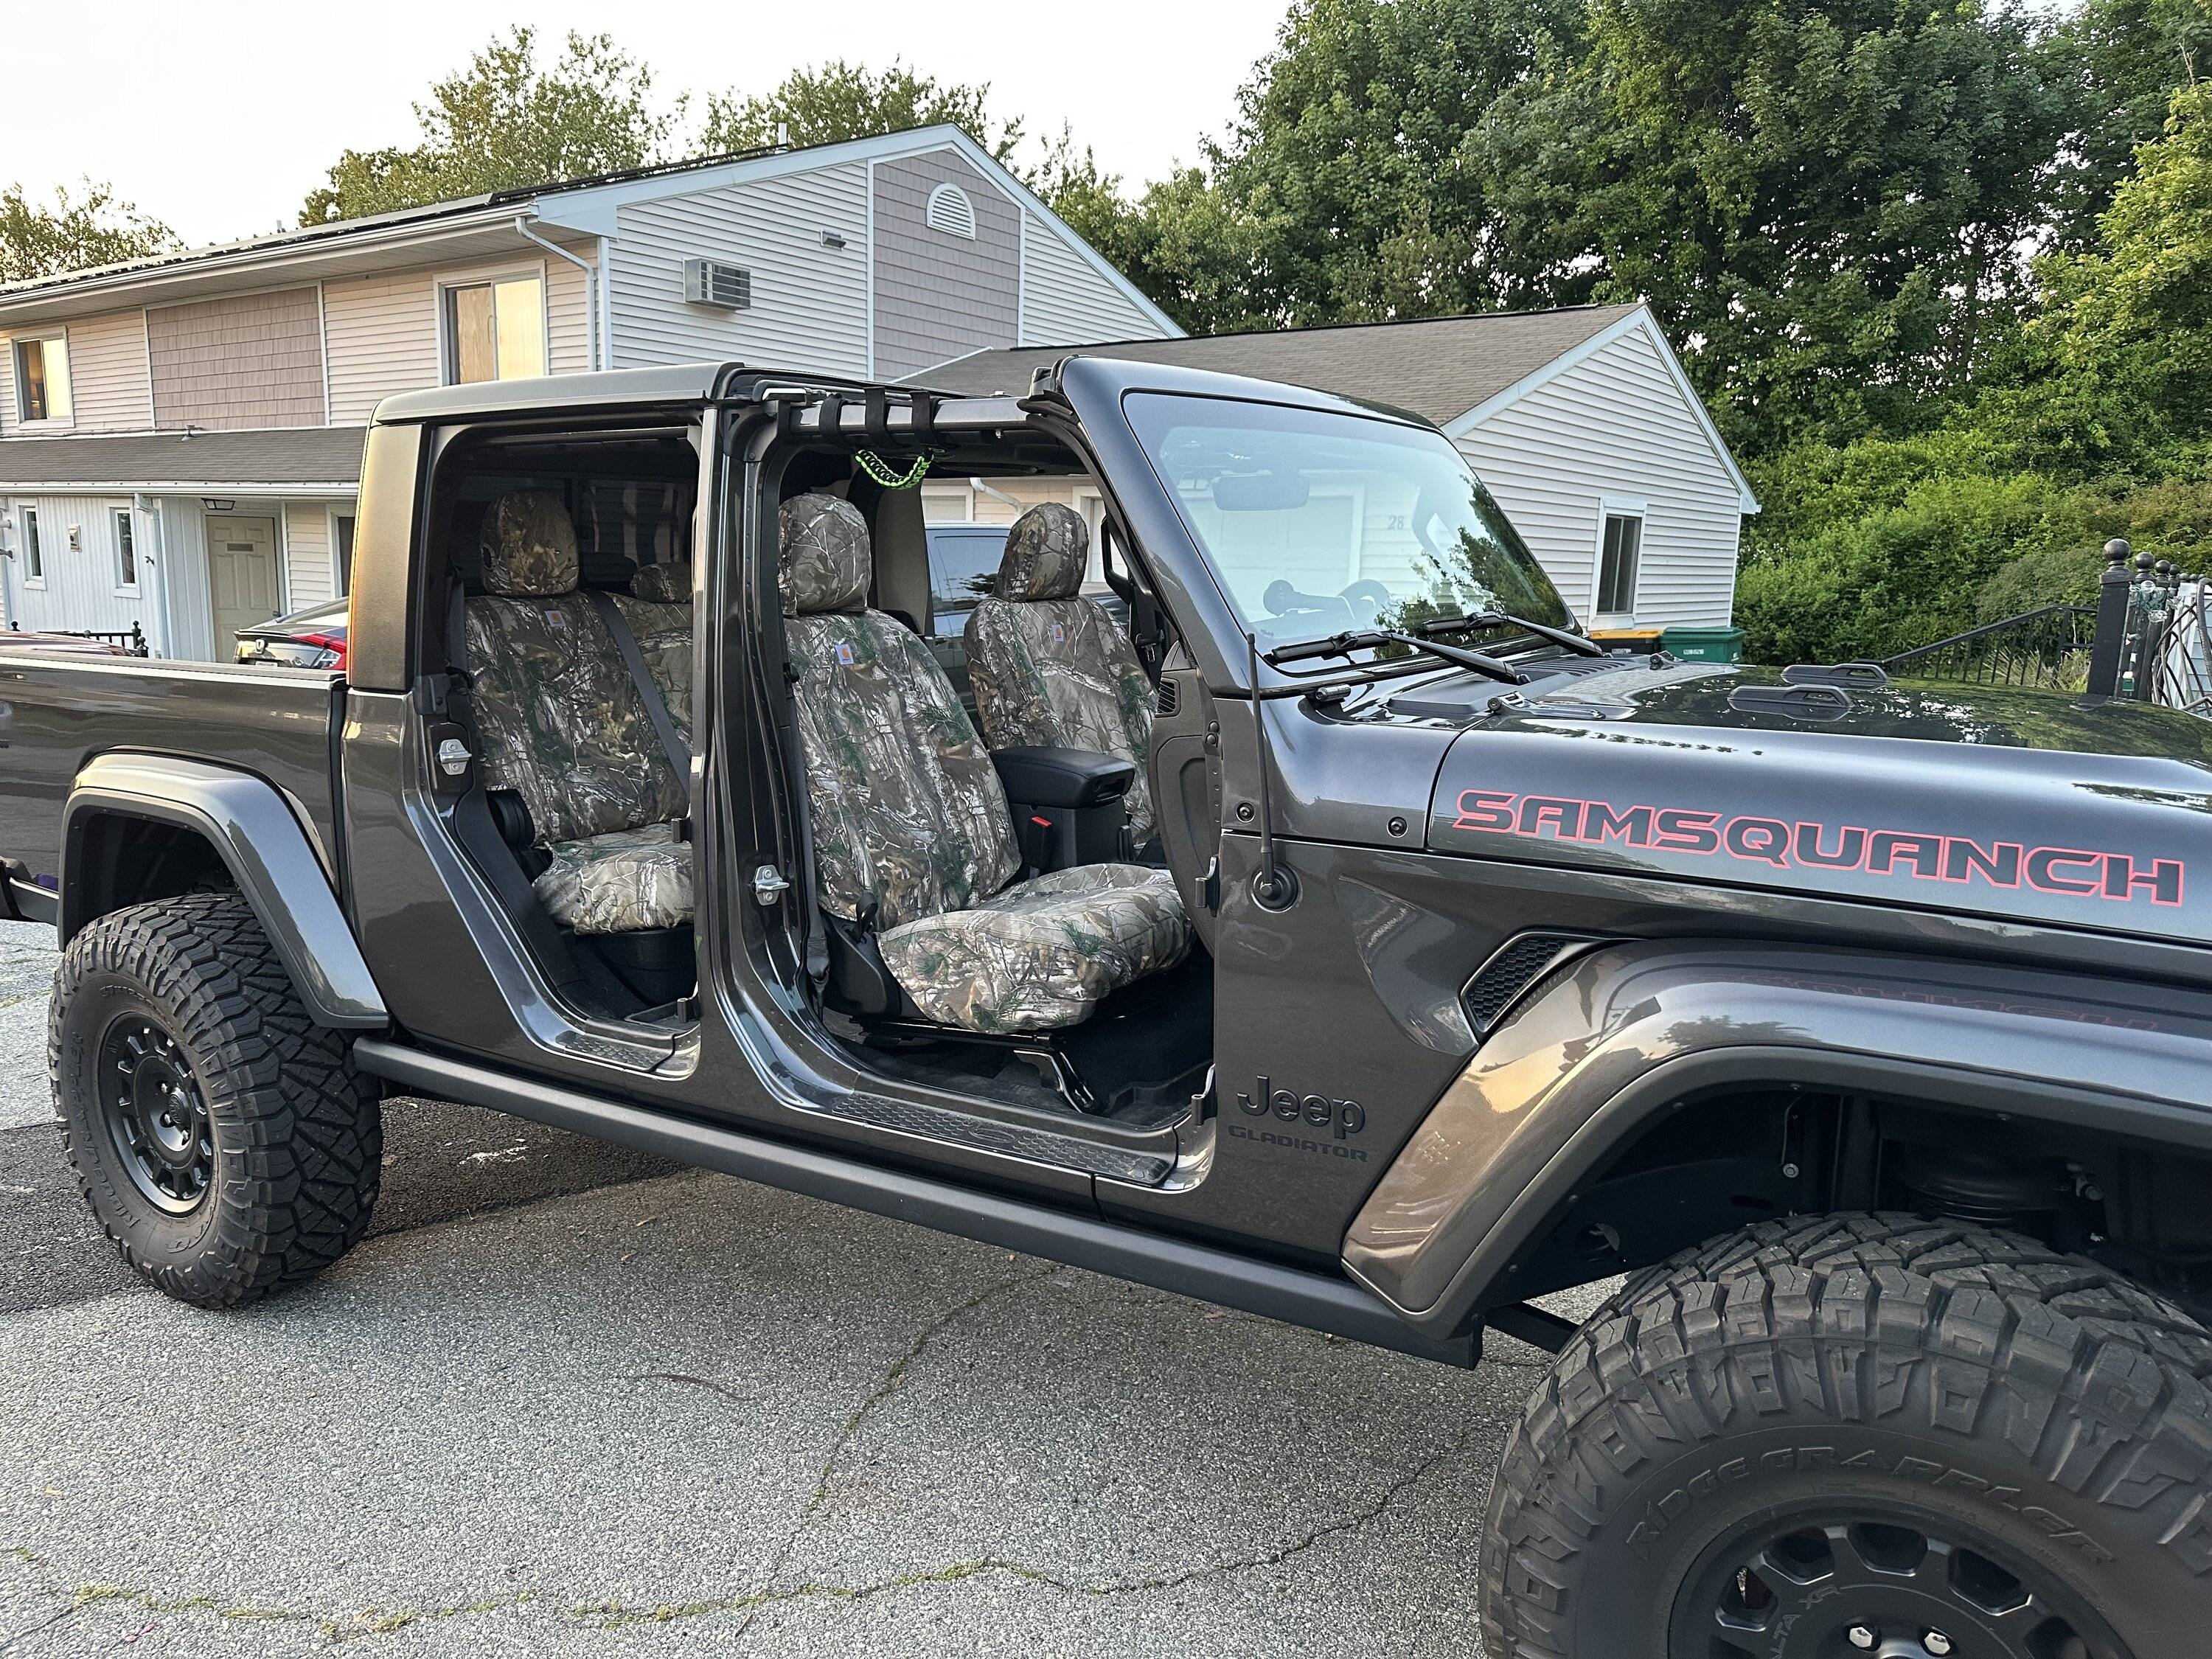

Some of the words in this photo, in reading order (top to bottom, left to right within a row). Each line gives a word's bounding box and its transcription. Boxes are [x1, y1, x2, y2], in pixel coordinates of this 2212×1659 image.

[1387, 515, 1404, 530] 28
[1453, 788, 2183, 907] SAMSQUANCH
[1237, 1074, 1366, 1140] Jeep
[1227, 1124, 1368, 1164] GLADIATOR
[1624, 1455, 1750, 1562] RIDGE
